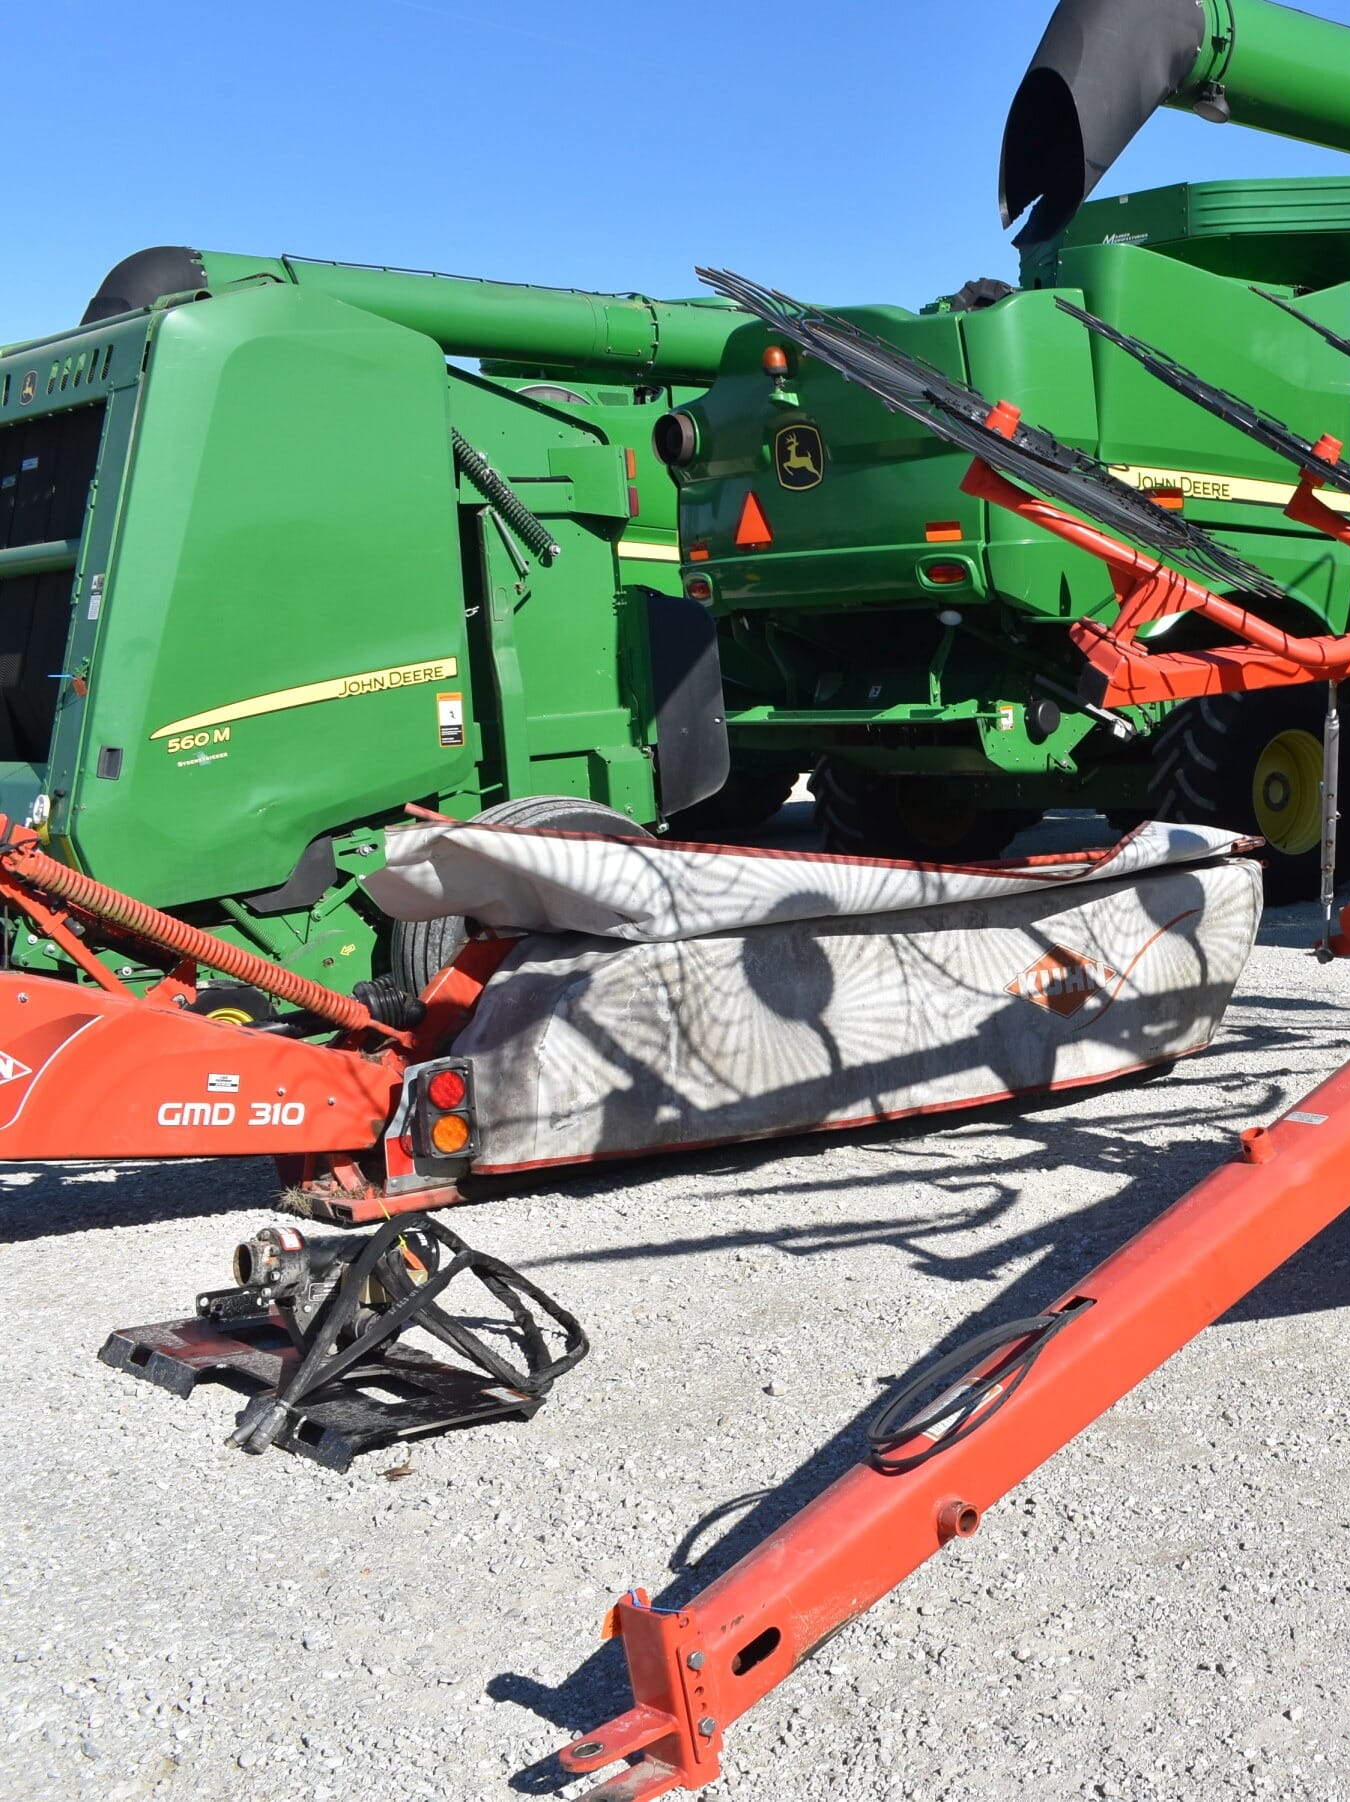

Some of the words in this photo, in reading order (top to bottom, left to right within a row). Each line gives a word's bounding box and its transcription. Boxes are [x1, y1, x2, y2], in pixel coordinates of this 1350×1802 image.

[1132, 472, 1177, 489] JOHN
[1180, 476, 1231, 497] DEERE
[338, 676, 385, 696] JOHN
[389, 666, 444, 686] DEERE
[167, 731, 210, 753] 560
[213, 727, 231, 743] M
[1017, 961, 1106, 999] KUHN
[157, 1102, 236, 1126] GMD
[247, 1102, 305, 1126] 310
